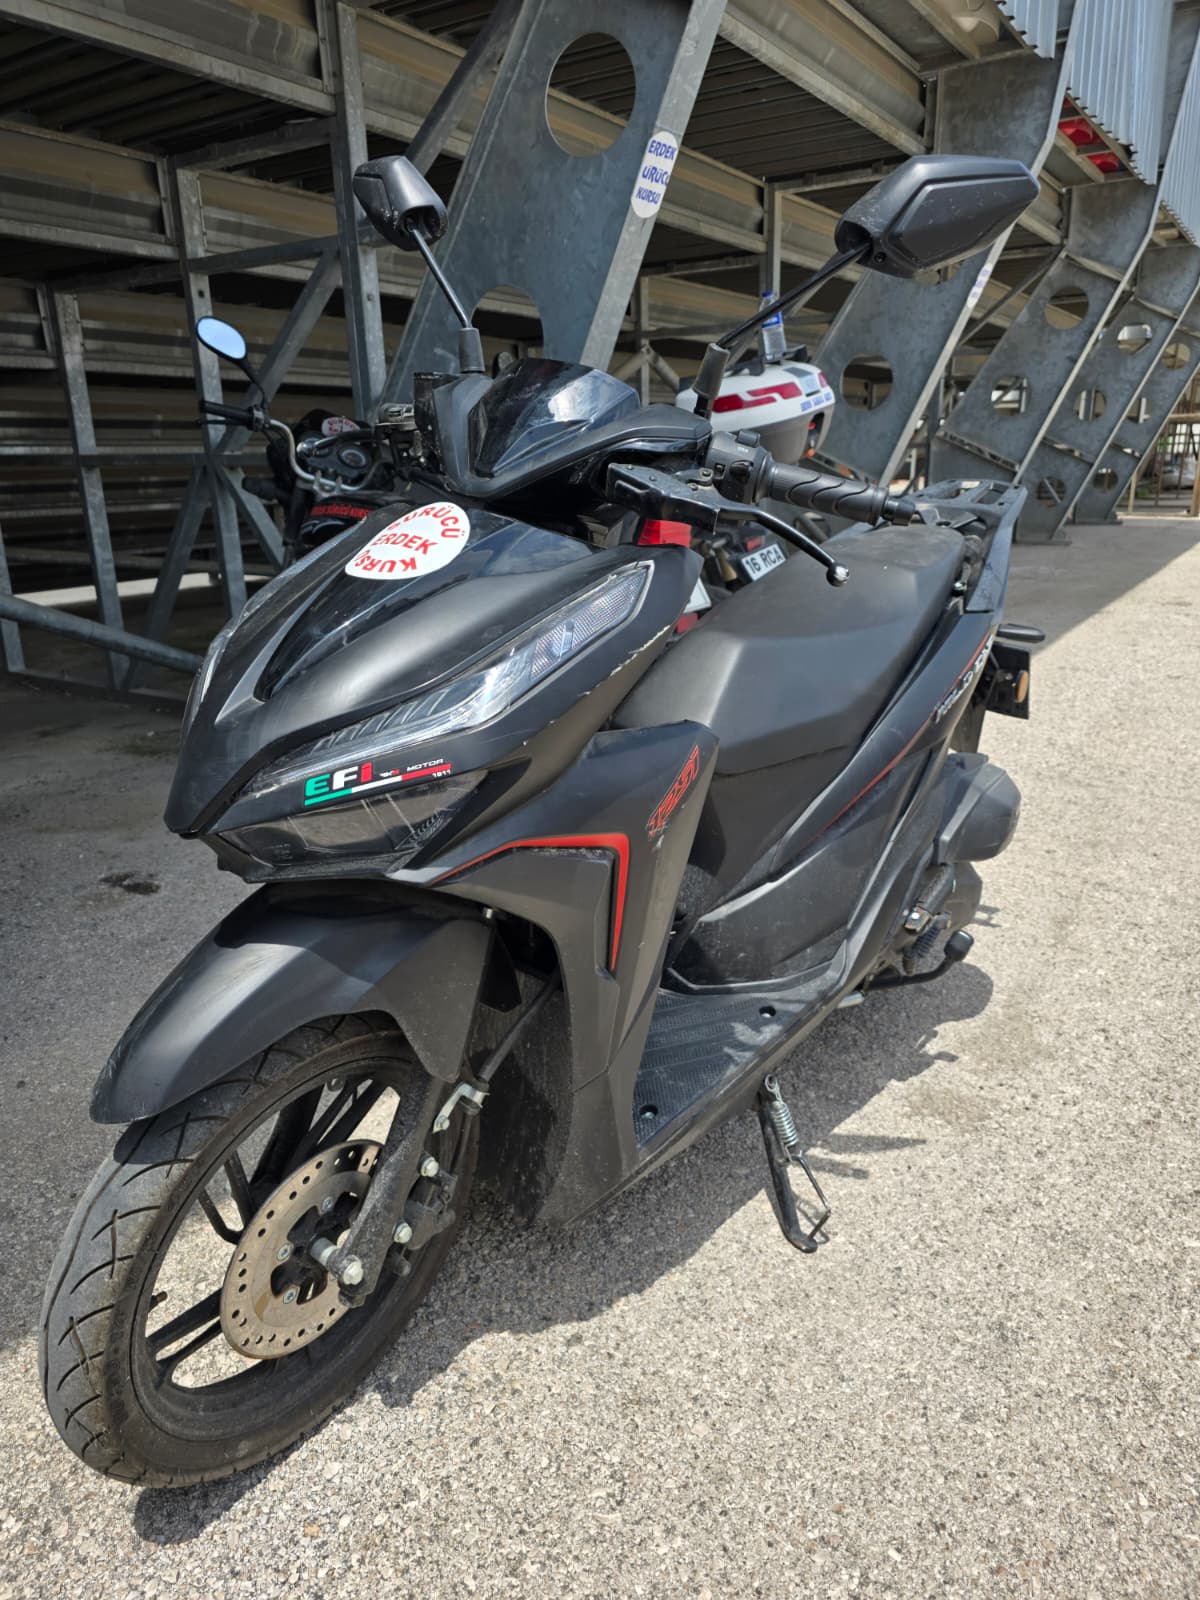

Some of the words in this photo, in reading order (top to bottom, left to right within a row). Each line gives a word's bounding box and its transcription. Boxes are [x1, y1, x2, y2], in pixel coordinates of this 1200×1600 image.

[648, 140, 676, 160] ERDEK
[371, 533, 438, 555] ERDEK
[746, 557, 760, 573] 16
[407, 759, 443, 771] MOTOR
